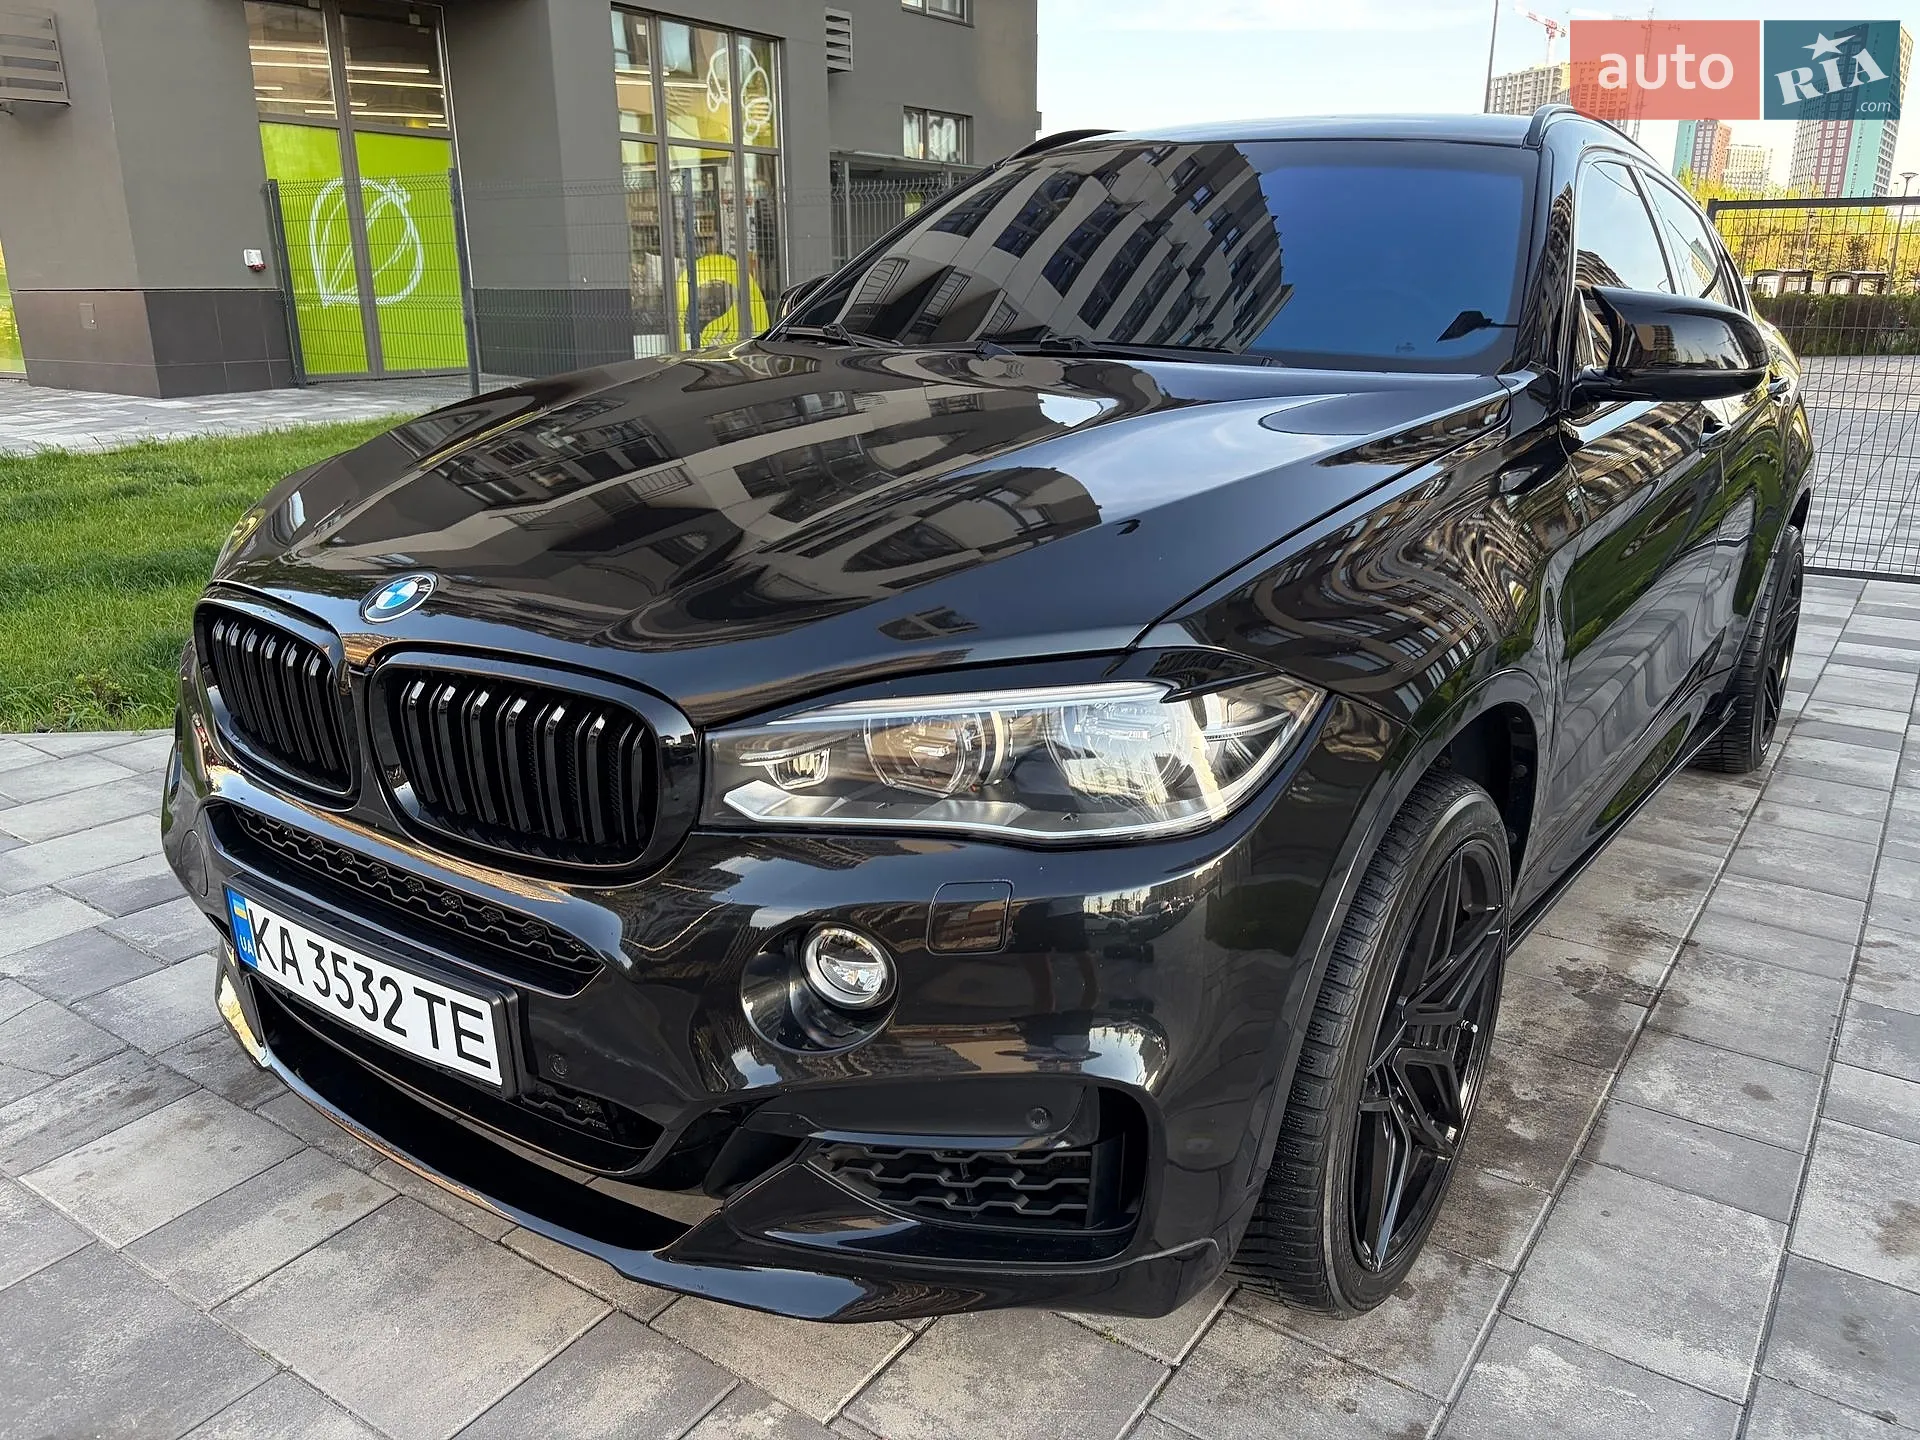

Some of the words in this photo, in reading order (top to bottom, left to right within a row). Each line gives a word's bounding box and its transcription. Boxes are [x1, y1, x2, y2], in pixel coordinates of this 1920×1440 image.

[239, 934, 255, 957] UA
[249, 909, 304, 986] KA
[307, 939, 407, 1038] 3532
[413, 987, 492, 1069] TE
